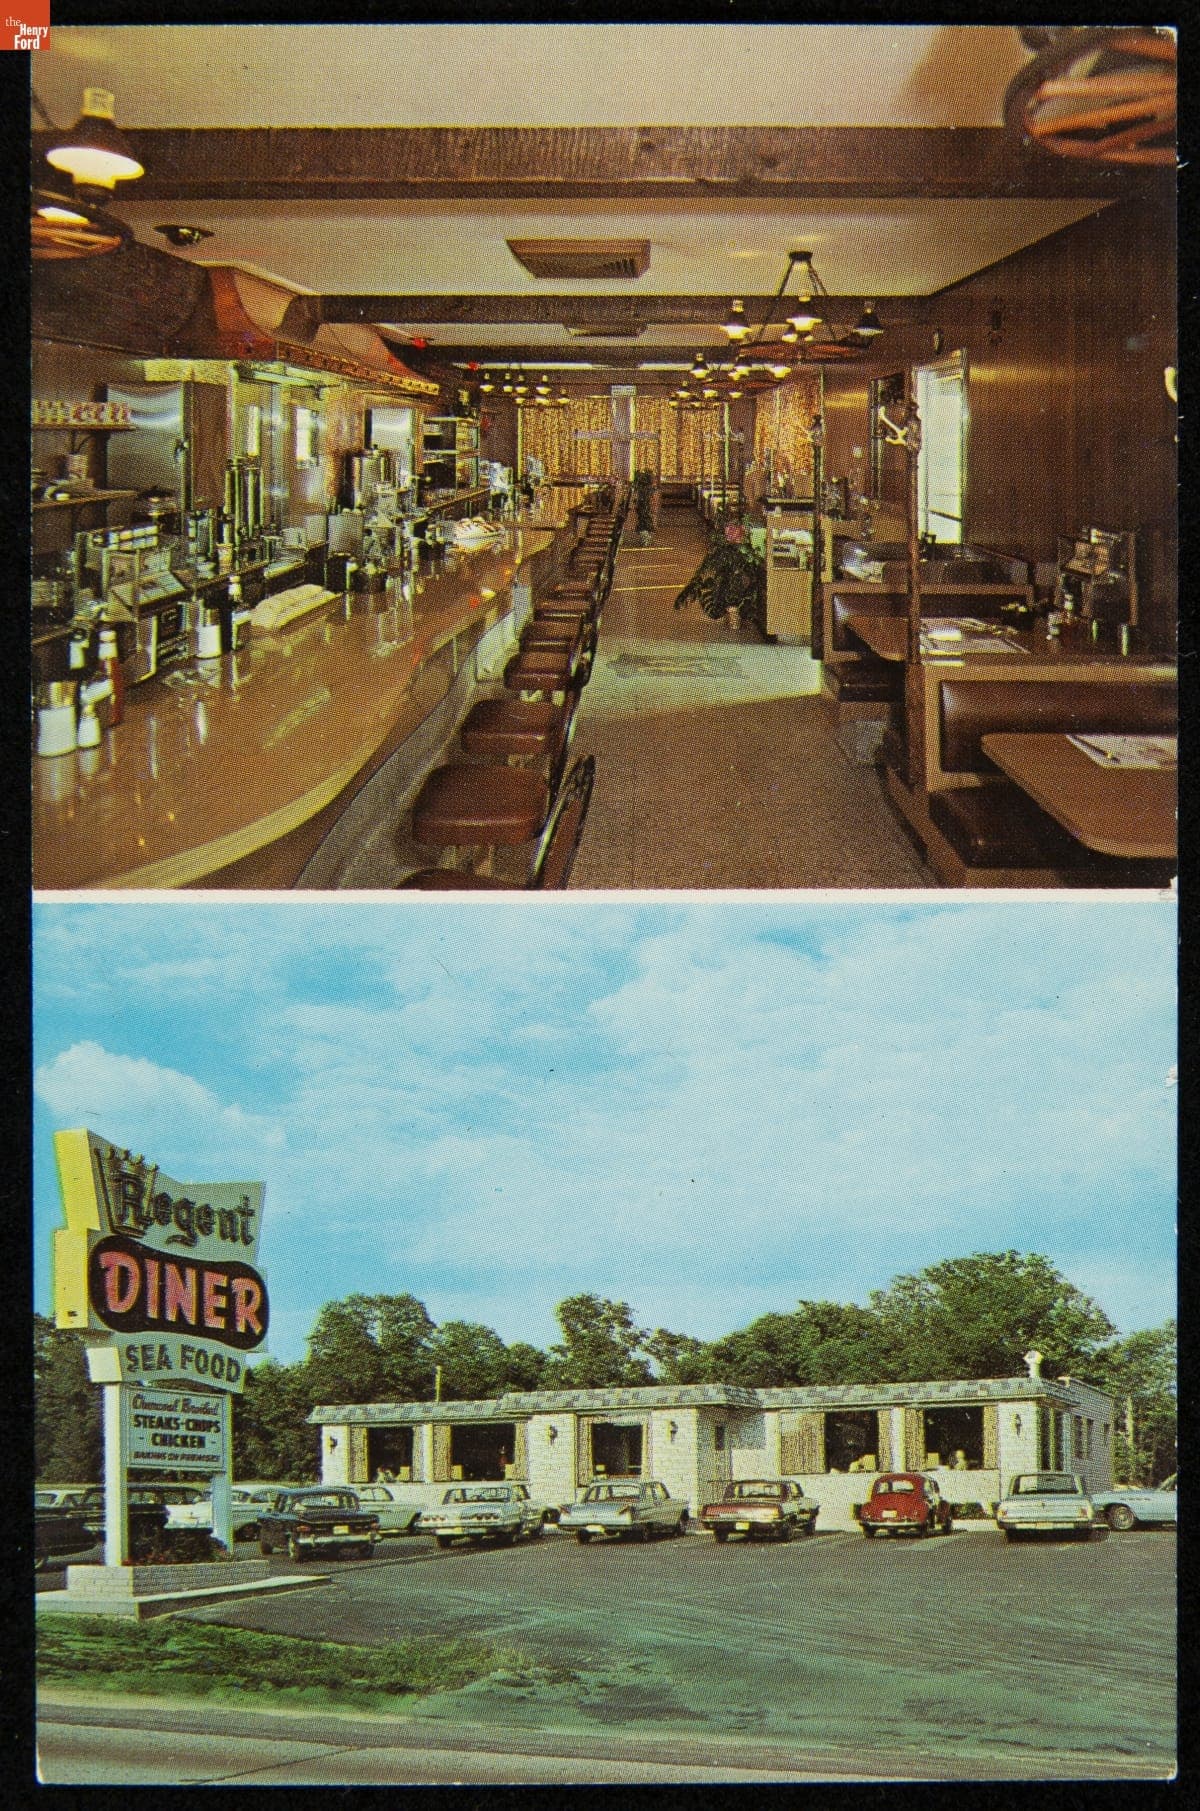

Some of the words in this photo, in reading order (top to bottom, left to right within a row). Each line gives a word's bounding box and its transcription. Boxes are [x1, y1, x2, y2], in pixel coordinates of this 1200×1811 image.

[112, 1172, 255, 1247] Regent
[98, 1250, 264, 1336] DINER
[126, 1344, 173, 1373] SEA
[180, 1344, 241, 1383] FOOD
[151, 1432, 206, 1449] CHICKEN
